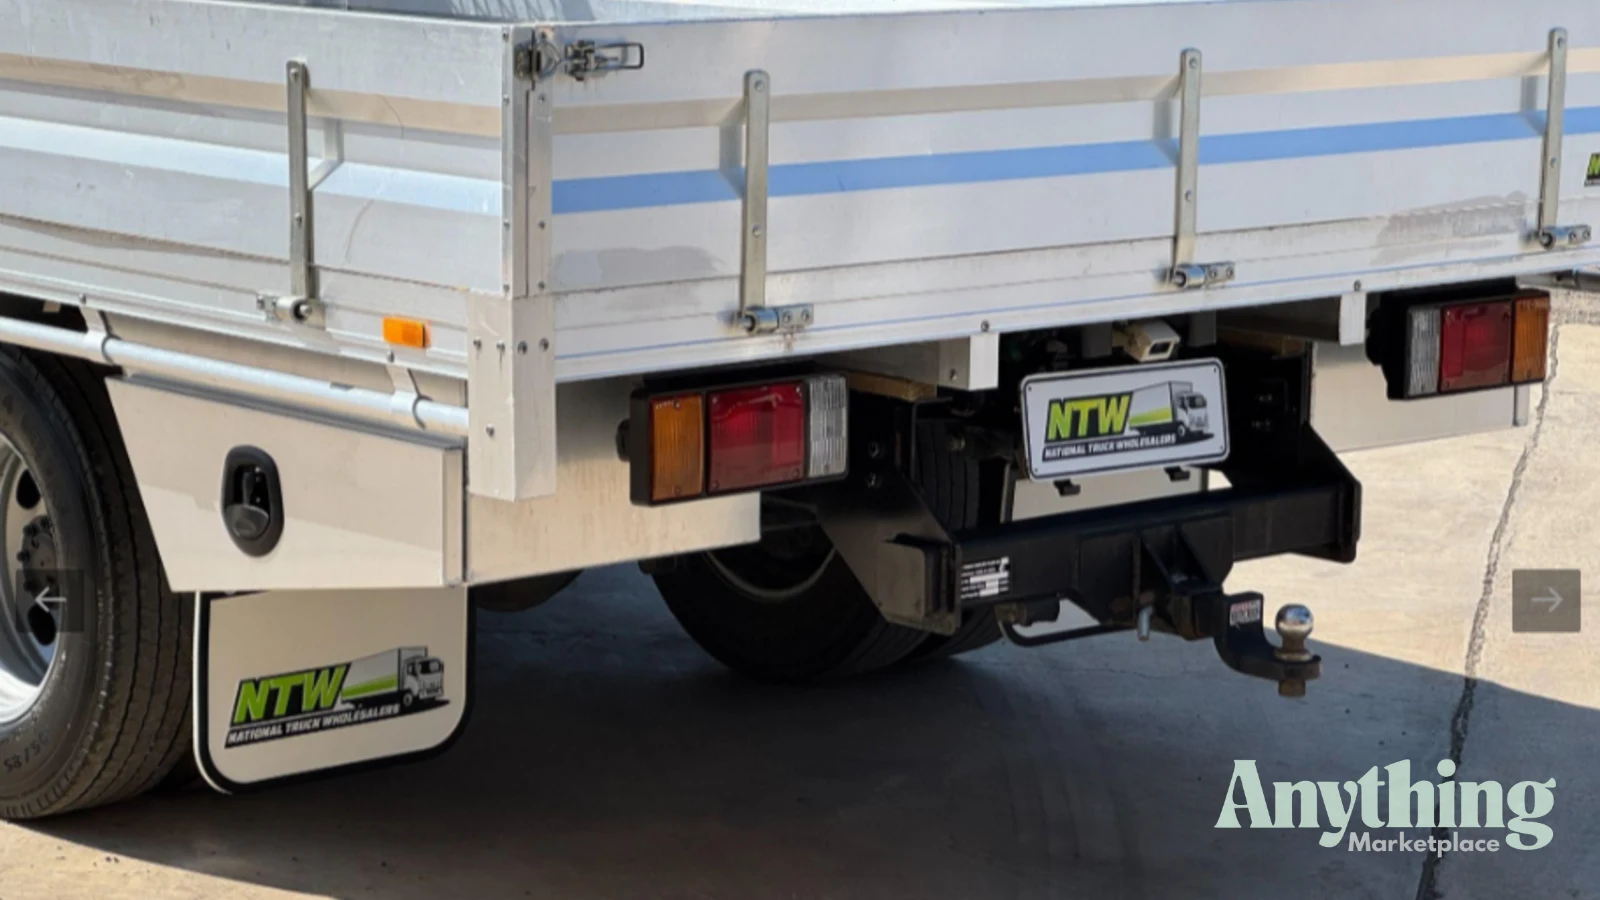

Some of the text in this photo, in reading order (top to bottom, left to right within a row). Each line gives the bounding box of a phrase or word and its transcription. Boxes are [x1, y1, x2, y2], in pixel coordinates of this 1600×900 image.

[1047, 394, 1130, 440] NTW
[1045, 432, 1177, 459] NATIONAL TRUCK WHOLESALERS
[233, 664, 347, 723] NTW
[228, 703, 401, 743] NATIONAL TRUCK WHOLESALERS
